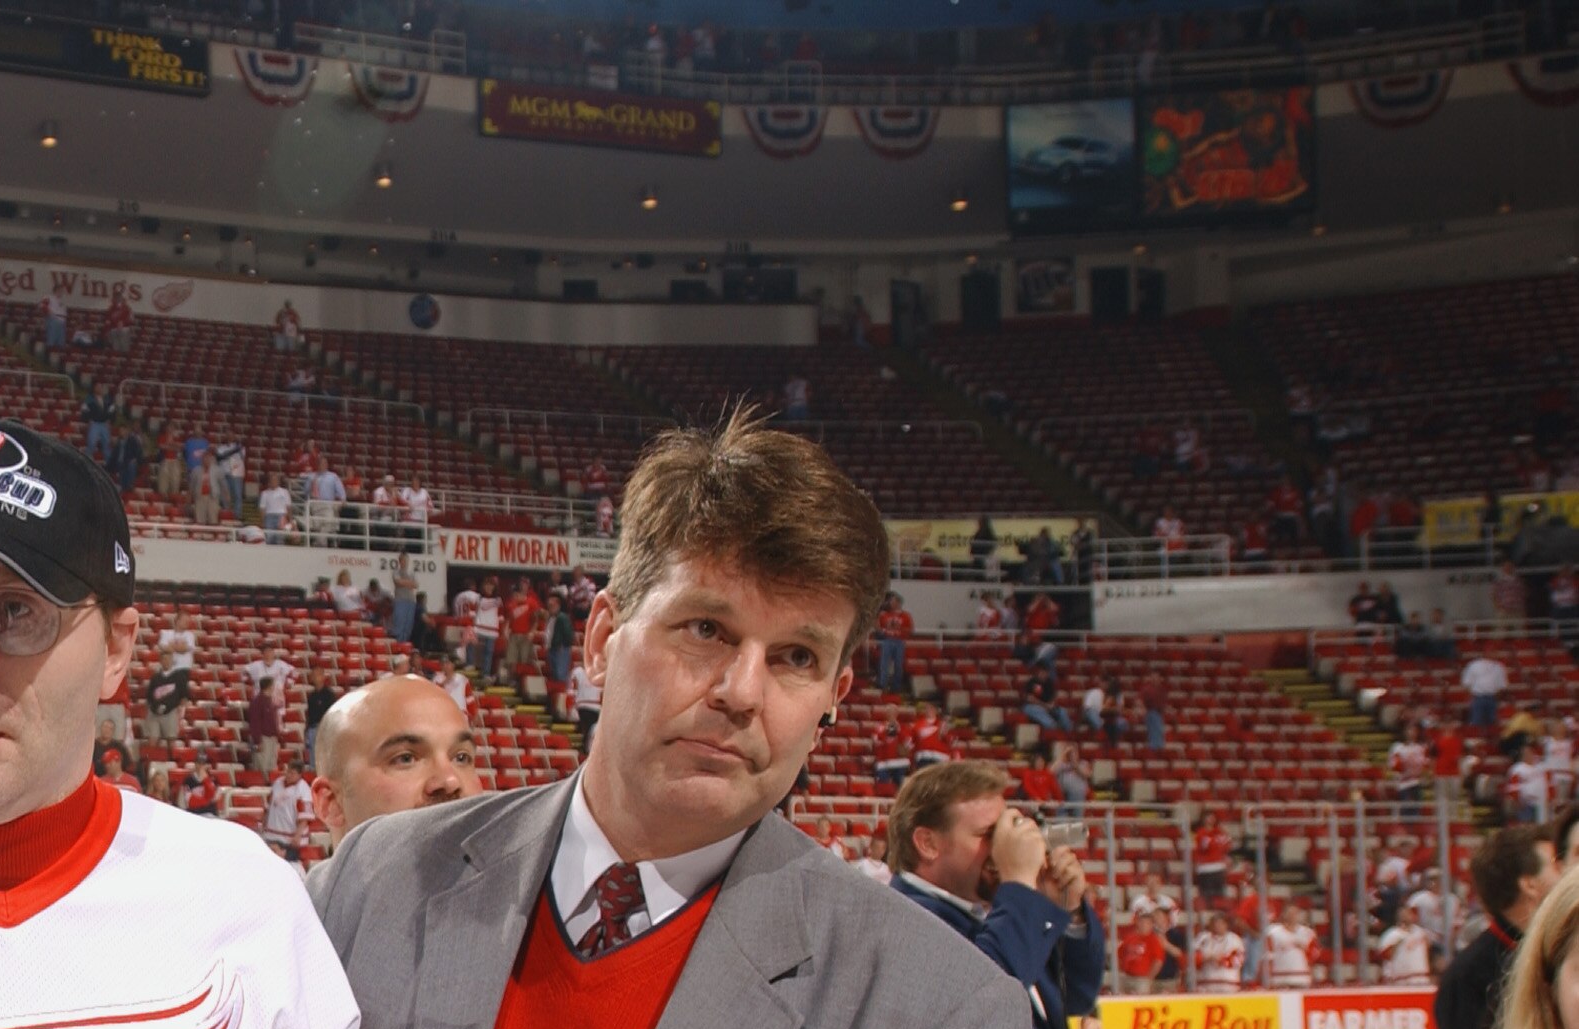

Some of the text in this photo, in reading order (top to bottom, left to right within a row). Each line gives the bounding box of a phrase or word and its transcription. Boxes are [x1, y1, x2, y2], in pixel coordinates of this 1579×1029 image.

[92, 28, 164, 50] THINK
[111, 46, 183, 67] FORD
[509, 95, 697, 132] MGM GRAND
[50, 270, 143, 302] Wings
[454, 534, 570, 567] ART MORAN
[414, 559, 437, 573] 210
